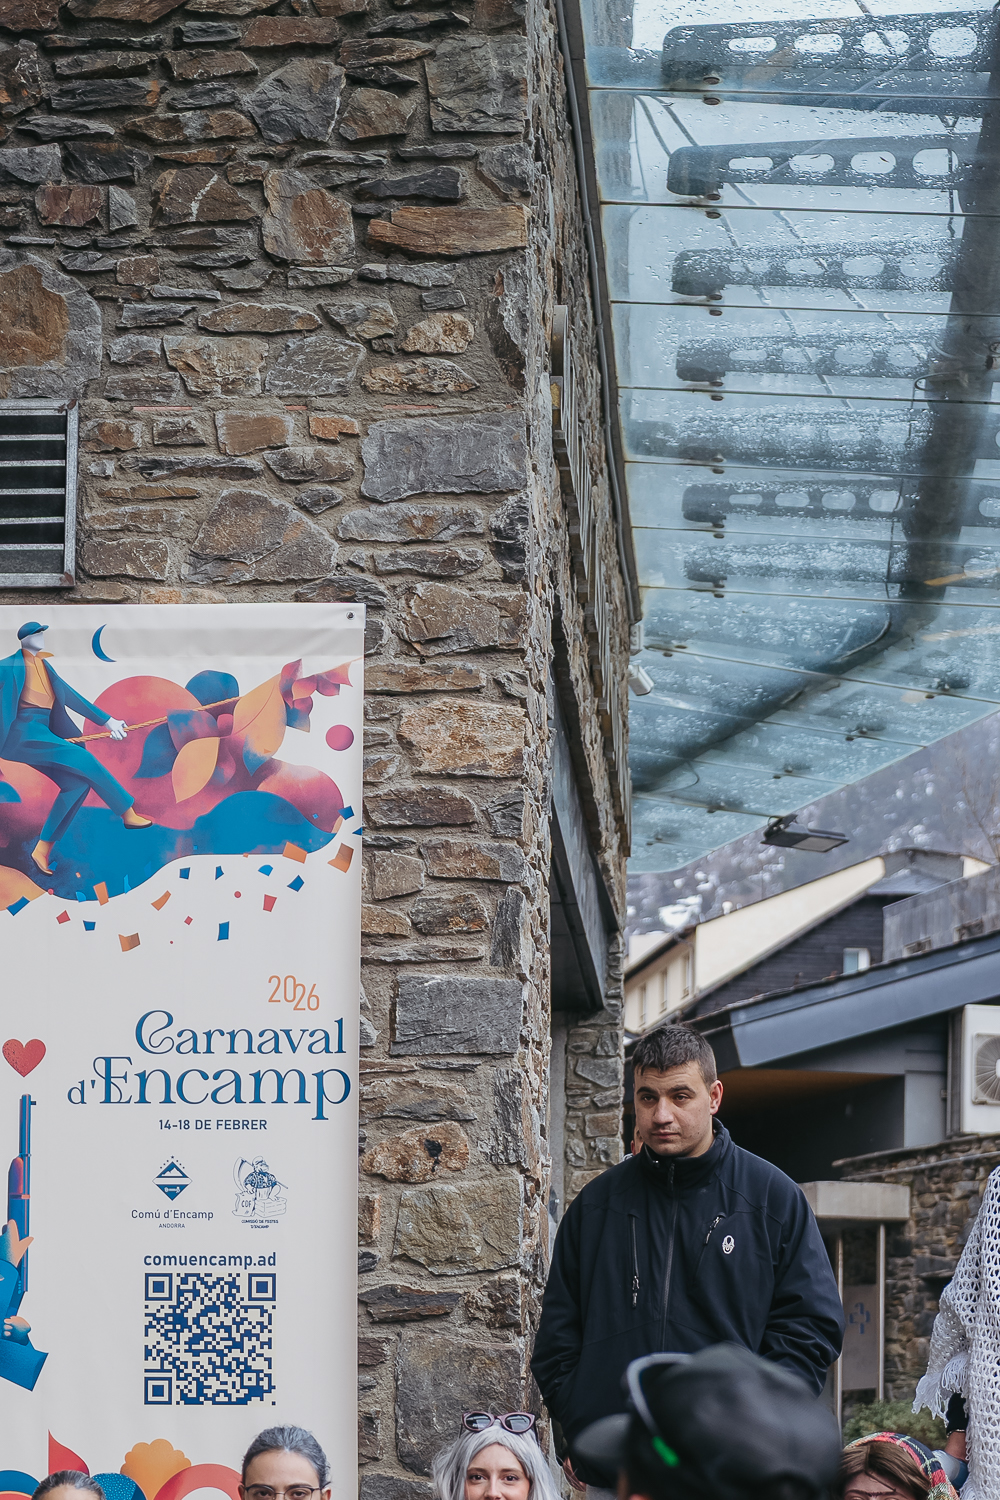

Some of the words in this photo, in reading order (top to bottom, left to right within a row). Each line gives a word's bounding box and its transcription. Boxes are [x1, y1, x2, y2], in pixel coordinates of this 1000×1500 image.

[267, 975, 320, 1011] 2026
[135, 1010, 347, 1055] Carnaval
[67, 1056, 352, 1121] d'Encamp
[158, 1119, 191, 1131] 14-18
[195, 1119, 212, 1131] DE
[216, 1119, 268, 1131] FEBRER
[131, 1208, 160, 1219] Comú
[163, 1209, 214, 1221] d'Encamp
[143, 1252, 277, 1270] comuencamp.ad
